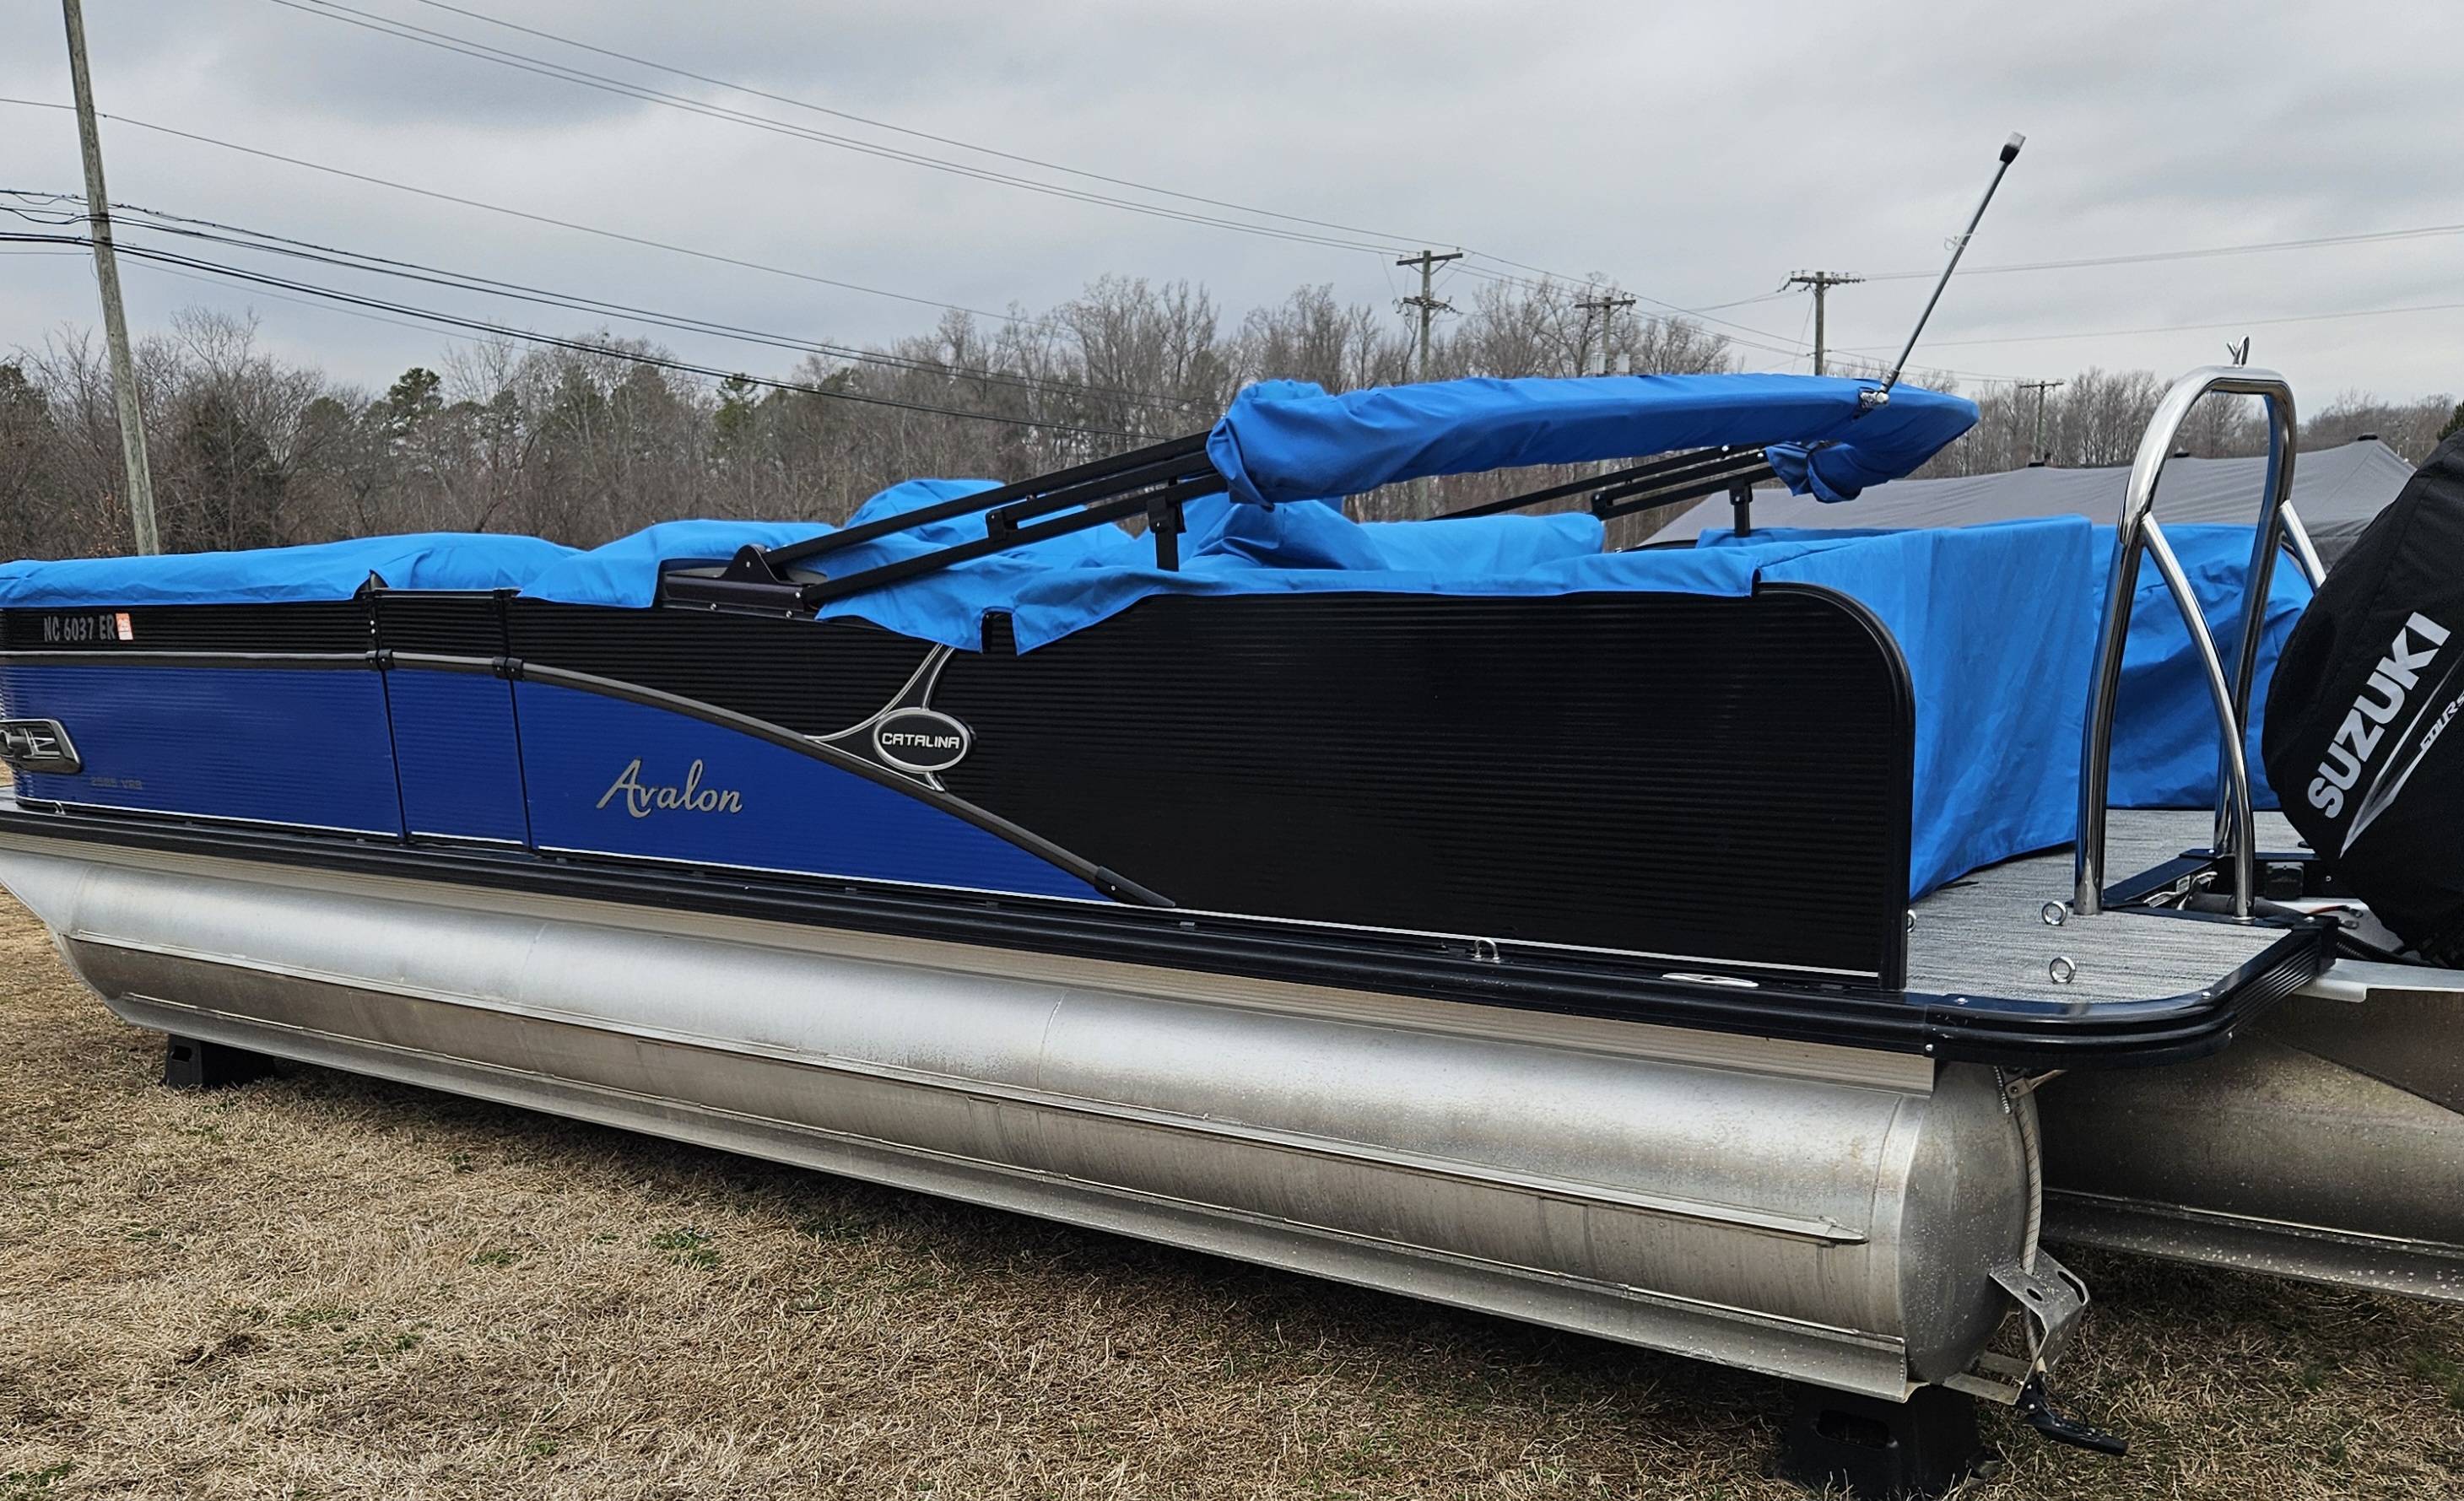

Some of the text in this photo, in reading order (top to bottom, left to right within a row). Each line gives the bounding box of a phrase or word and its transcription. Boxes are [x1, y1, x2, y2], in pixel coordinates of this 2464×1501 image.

[44, 614, 116, 641] NC 6037 ER
[2307, 612, 2451, 818] SUZUKI
[882, 732, 960, 749] CATALINA
[596, 758, 743, 818] Avalon
